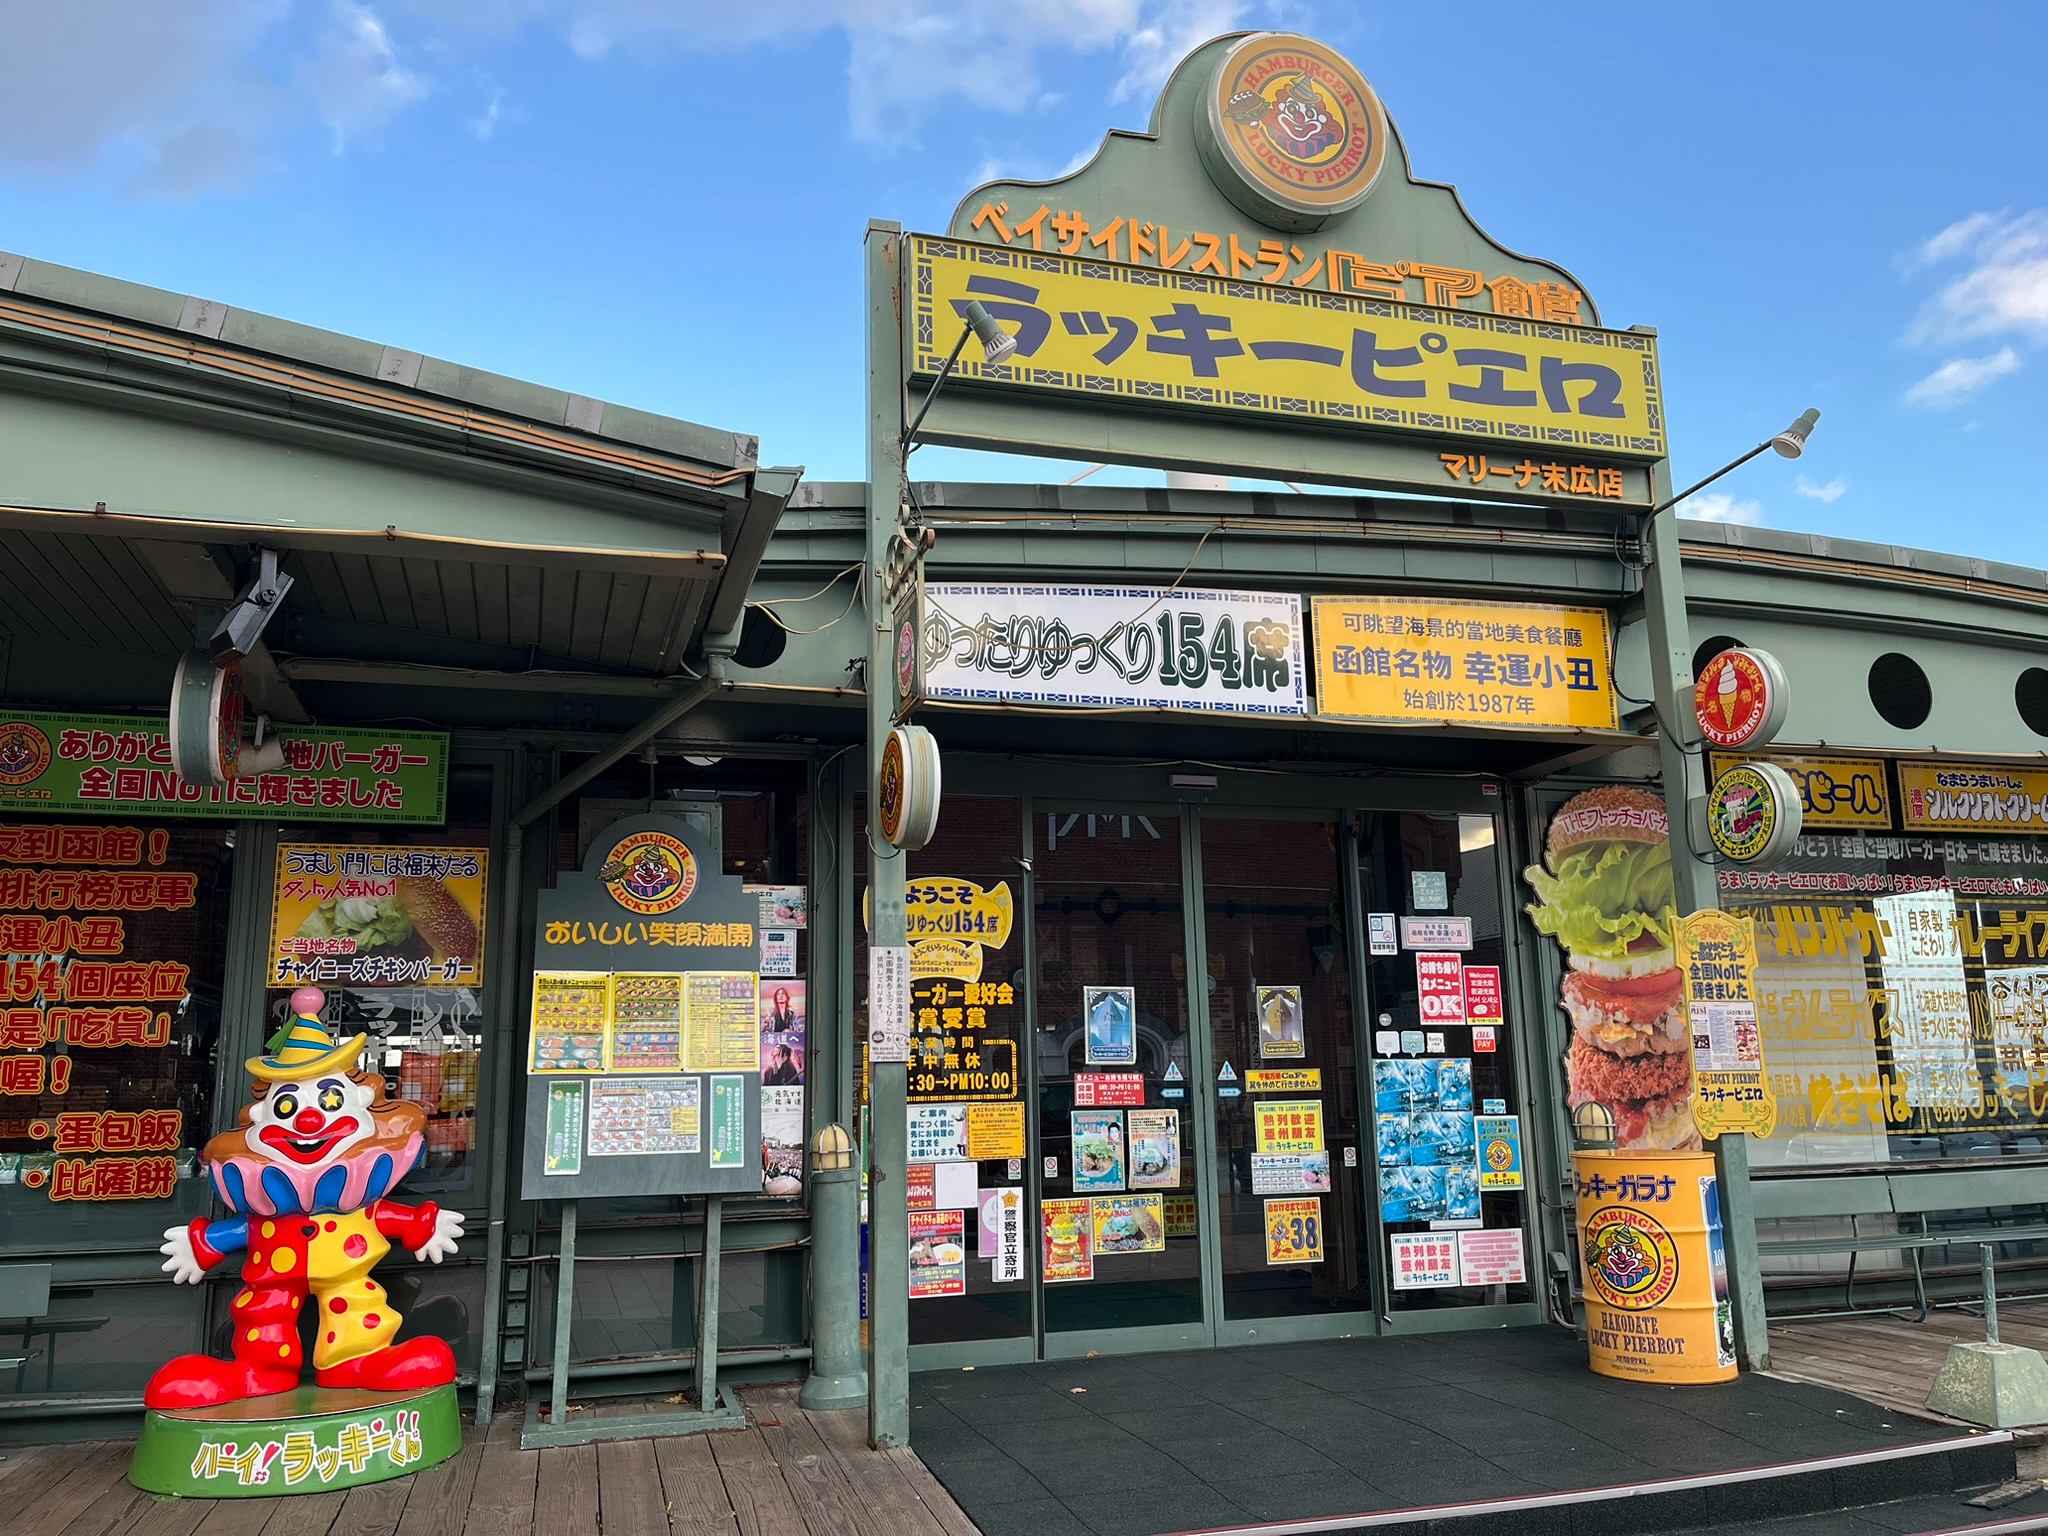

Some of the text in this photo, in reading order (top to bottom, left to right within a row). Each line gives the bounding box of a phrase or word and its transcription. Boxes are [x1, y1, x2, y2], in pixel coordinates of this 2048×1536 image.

[1243, 53, 1358, 114] HAMBURGER
[1246, 121, 1367, 188] LUCKY PIERROT
[970, 200, 1326, 288] ベイサイドレストラン
[948, 272, 1630, 421] ラッキーピエロ
[1440, 452, 1626, 500] マリーナ末広店
[1341, 611, 1585, 650] 可眺望海景的當地美食餐廳
[924, 606, 1292, 695] ゆったりゆっくり154席
[1331, 642, 1600, 694] 函館名物 幸運小丑
[1402, 689, 1537, 716] 始創於1987年
[1696, 699, 1763, 743] LUCKY PIERROT
[1936, 772, 2024, 790] なまらうまいっしょ
[1910, 787, 1926, 820] 濃厚
[613, 832, 690, 862] HAMBURGER
[284, 850, 479, 880] うまい門には福来たる
[611, 868, 697, 913] LUCKY PIERROT
[906, 884, 975, 905] ようこそ
[1771, 905, 1892, 958] ハンバーガー
[1908, 909, 1945, 933] 自家製
[0, 915, 124, 956] 運小丑
[544, 919, 754, 949] おいしい笑顔満開
[277, 935, 357, 961] ご当地名物
[1699, 942, 1734, 953] ありがとう
[1911, 936, 1945, 957] こだわり
[275, 960, 473, 989] チャイニーズチキンバーガー
[1420, 961, 1459, 975] お持ち帰り
[1468, 972, 1495, 980] Welcome
[1690, 963, 1748, 983] 全国No1に
[1421, 977, 1460, 991] 全メニュー
[1692, 982, 1750, 1001] 輝きました
[1422, 995, 1463, 1017] OK
[908, 1007, 988, 1030] 賞受賞
[909, 1035, 976, 1051] 営業時間
[1475, 1030, 1492, 1039] au
[1477, 1040, 1493, 1049] PAY
[905, 1053, 983, 1071] 年中無休
[1710, 1072, 1760, 1086] LUCKY PIERROT
[1700, 1086, 1765, 1103] ラッキーピエロ
[919, 1109, 948, 1118] ご案内
[1258, 1105, 1277, 1113] WELCOME
[1286, 1105, 1300, 1113] LUCKY
[55, 1110, 183, 1153] 蛋包飯
[910, 1120, 955, 1130] 席につく前に
[910, 1129, 956, 1139] 先にお料理の
[910, 1139, 940, 1148] ご注文を
[1276, 1142, 1314, 1151] ラッキーピエロ
[1258, 1157, 1301, 1165] ラッキーピエロ
[50, 1156, 178, 1200] 比薩餅
[1290, 1216, 1319, 1251] 38
[1588, 1211, 1666, 1244] HAMBURGER
[1004, 1209, 1018, 1279] 警察官立寄所
[1394, 1237, 1413, 1245] WELCOME
[1421, 1236, 1435, 1244] LUCKY
[1308, 1249, 1321, 1260] th
[1412, 1273, 1450, 1283] ラッキーピエロ
[1592, 1254, 1675, 1309] LUCKY PIERROT
[1600, 1311, 1660, 1336] HAKODATE
[1590, 1327, 1686, 1356] LUCKY PIERROT
